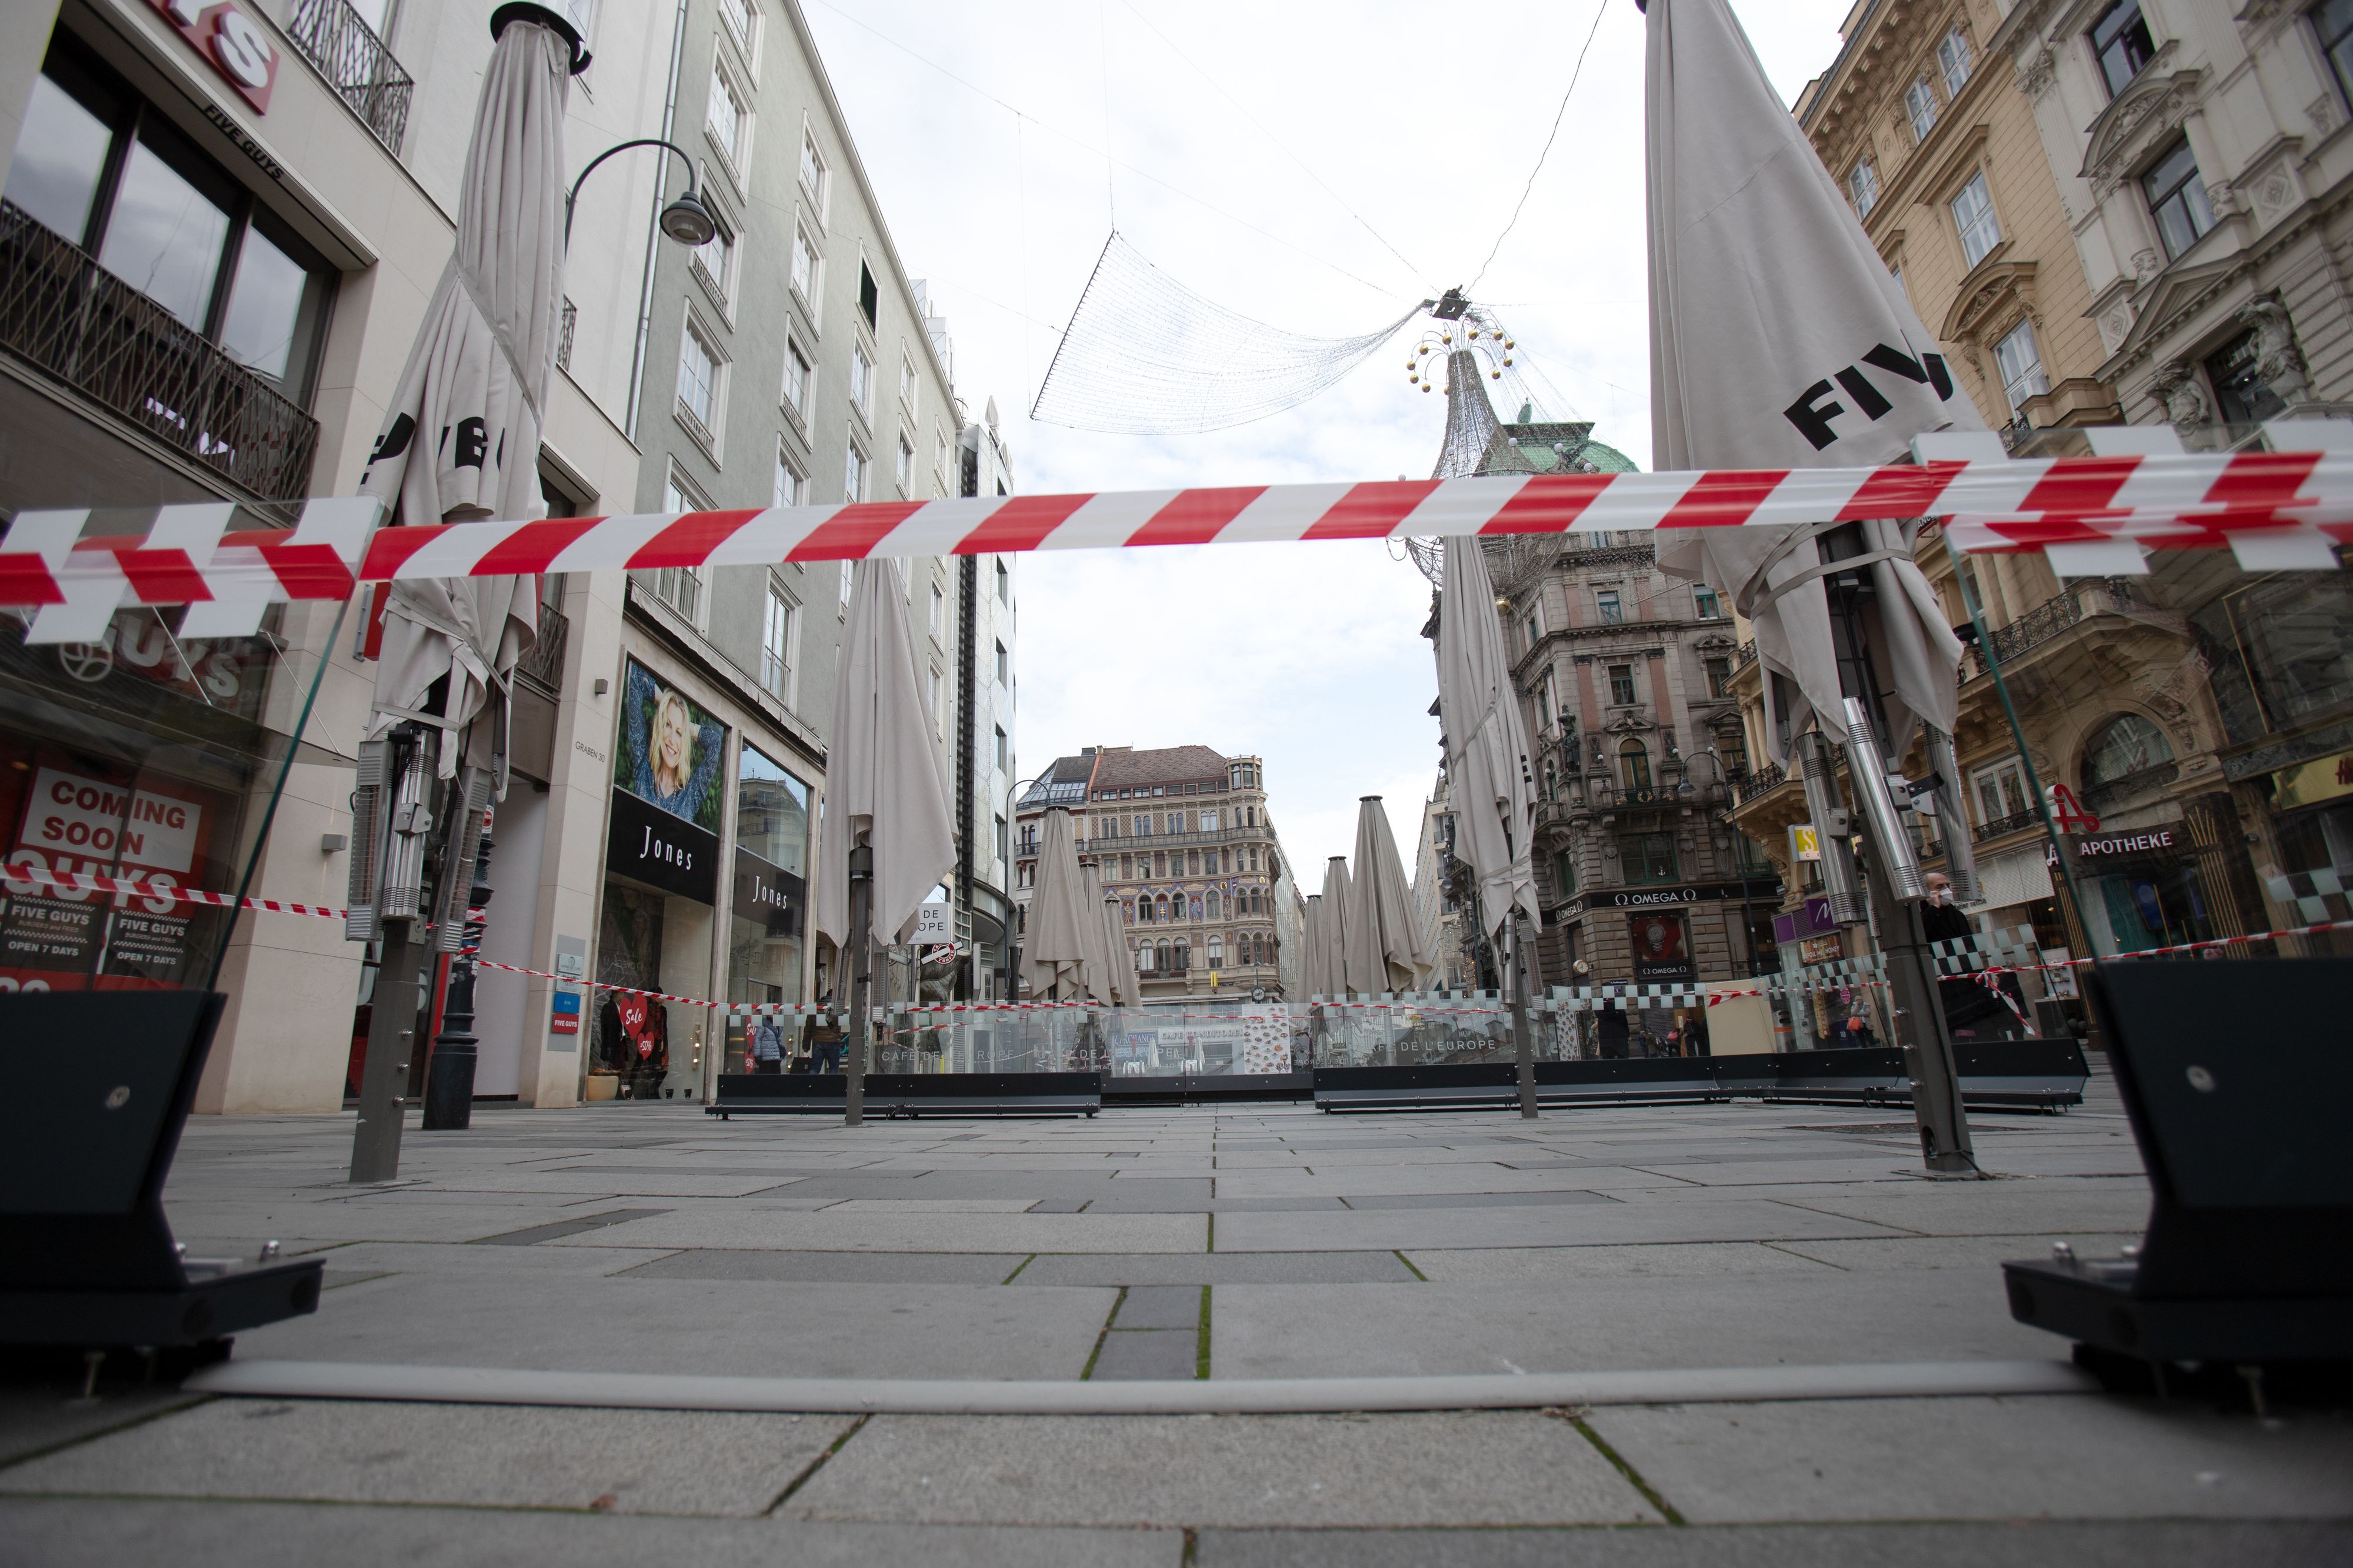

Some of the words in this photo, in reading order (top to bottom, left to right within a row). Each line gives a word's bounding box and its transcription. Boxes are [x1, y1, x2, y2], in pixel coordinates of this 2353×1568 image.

[202, 104, 243, 141] FIVE
[242, 139, 286, 179] GUYS
[89, 616, 242, 698] UYS
[575, 741, 598, 759] GRABEN
[598, 753, 605, 763] 30
[51, 780, 186, 830] COMING
[42, 816, 145, 856] SOON
[2080, 832, 2172, 856] APOTHEKE
[640, 825, 693, 872] Jones
[4, 849, 178, 914] GUYS
[753, 875, 788, 911] Jones
[1632, 892, 1679, 905] OMEGA
[1969, 898, 1987, 907] suisse
[11, 905, 45, 922] FIVE
[46, 909, 91, 926] GUYS
[923, 910, 939, 919] DE
[1562, 906, 1577, 919] OMEGA
[119, 918, 148, 932] FIVE
[151, 923, 186, 936] GUYS
[125, 932, 151, 940] BURGERS
[8, 941, 39, 953] OPEN
[42, 945, 49, 953] 7
[52, 945, 79, 957] DAYS
[938, 950, 955, 963] TRAFIK
[1804, 950, 1816, 959] SPOIL
[1825, 945, 1839, 954] HONEY
[117, 951, 144, 961] OPEN
[154, 955, 177, 965] DAYS
[625, 1008, 644, 1025] Sale
[1080, 1049, 1098, 1059] DE
[1401, 1042, 1419, 1052] DE
[1425, 1040, 1496, 1051] L'EUROPE
